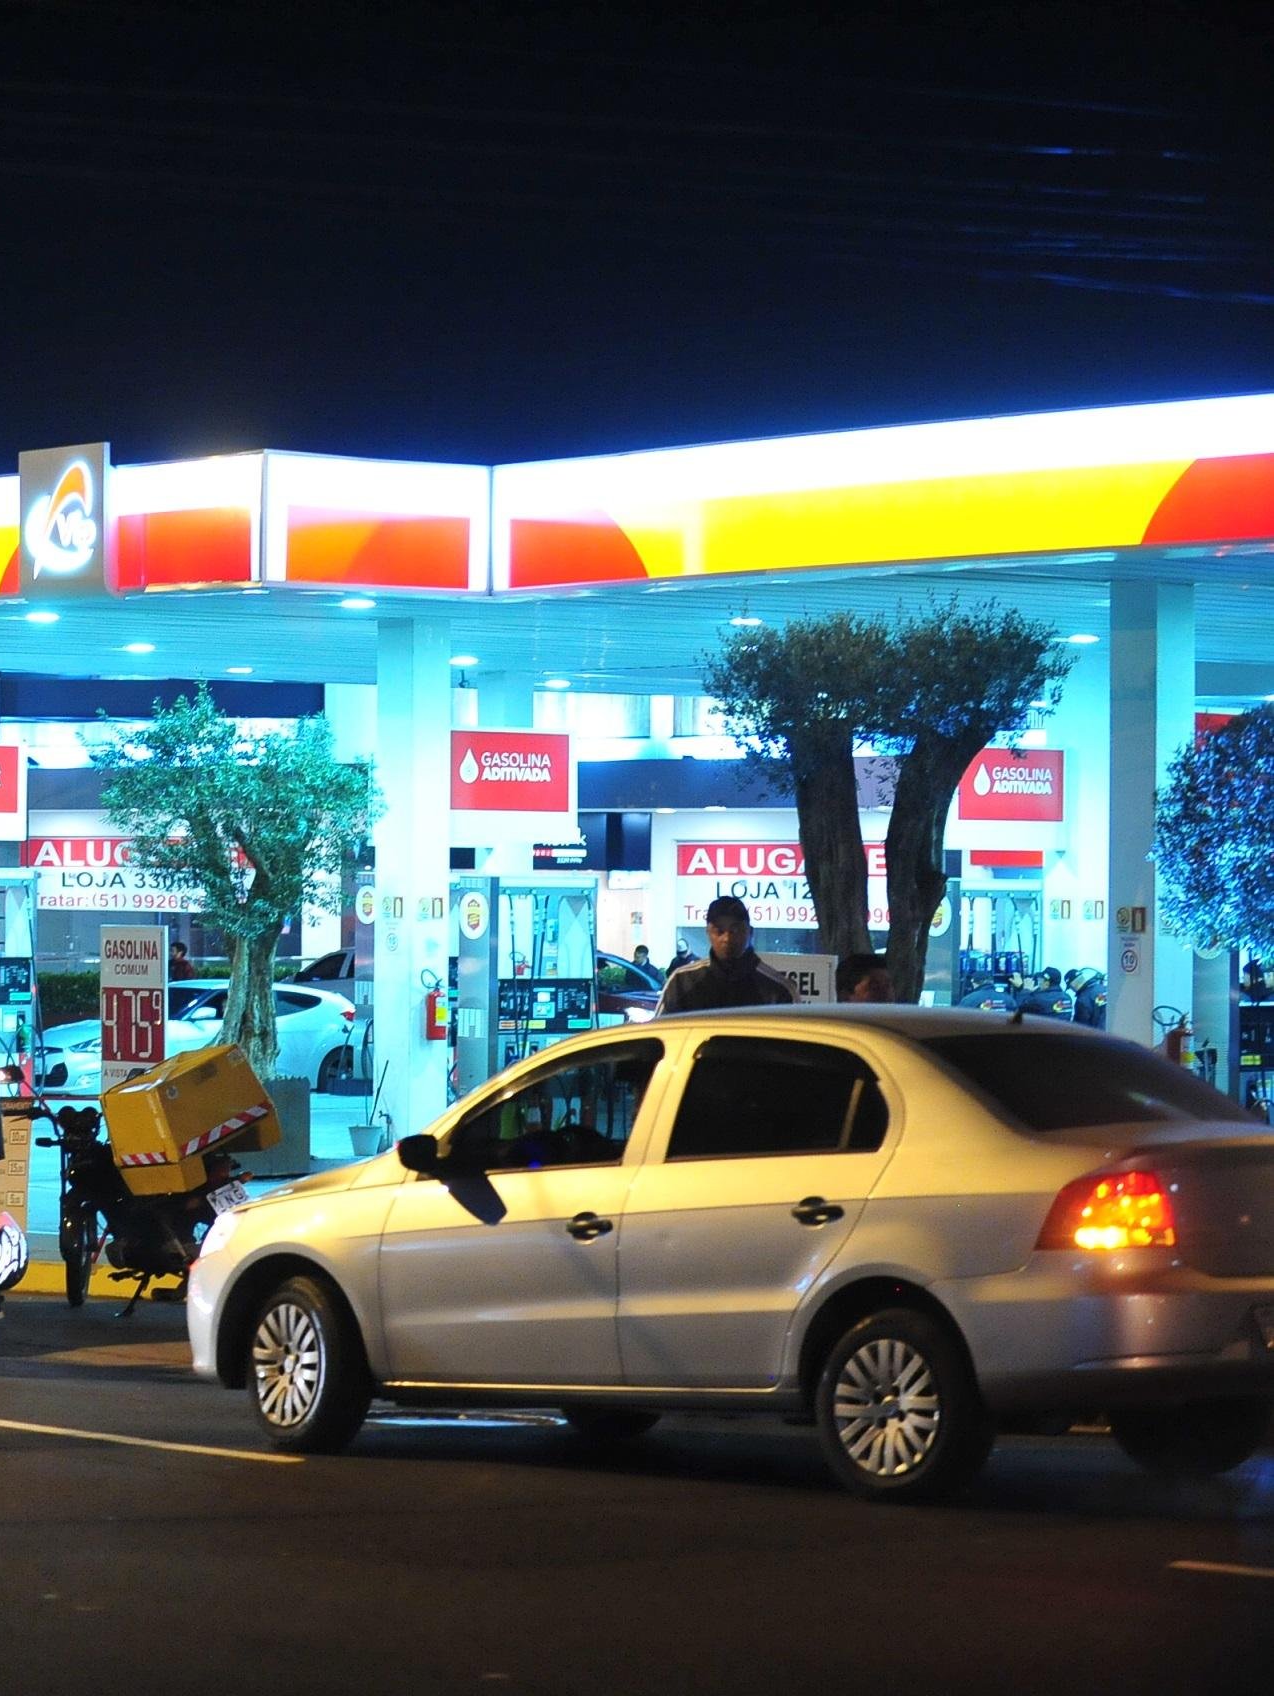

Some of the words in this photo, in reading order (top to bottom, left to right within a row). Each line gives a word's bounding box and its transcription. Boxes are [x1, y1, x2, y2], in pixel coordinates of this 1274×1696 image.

[481, 751, 552, 767] GASOLINA
[481, 766, 552, 782] ADITIVADA
[992, 766, 1054, 781] GASOLINA
[992, 780, 1054, 795] ADITIVADA
[62, 871, 126, 888] LOJA
[716, 882, 780, 899] LOJA
[104, 940, 159, 960] GASOLINA
[114, 963, 149, 976] COMUM
